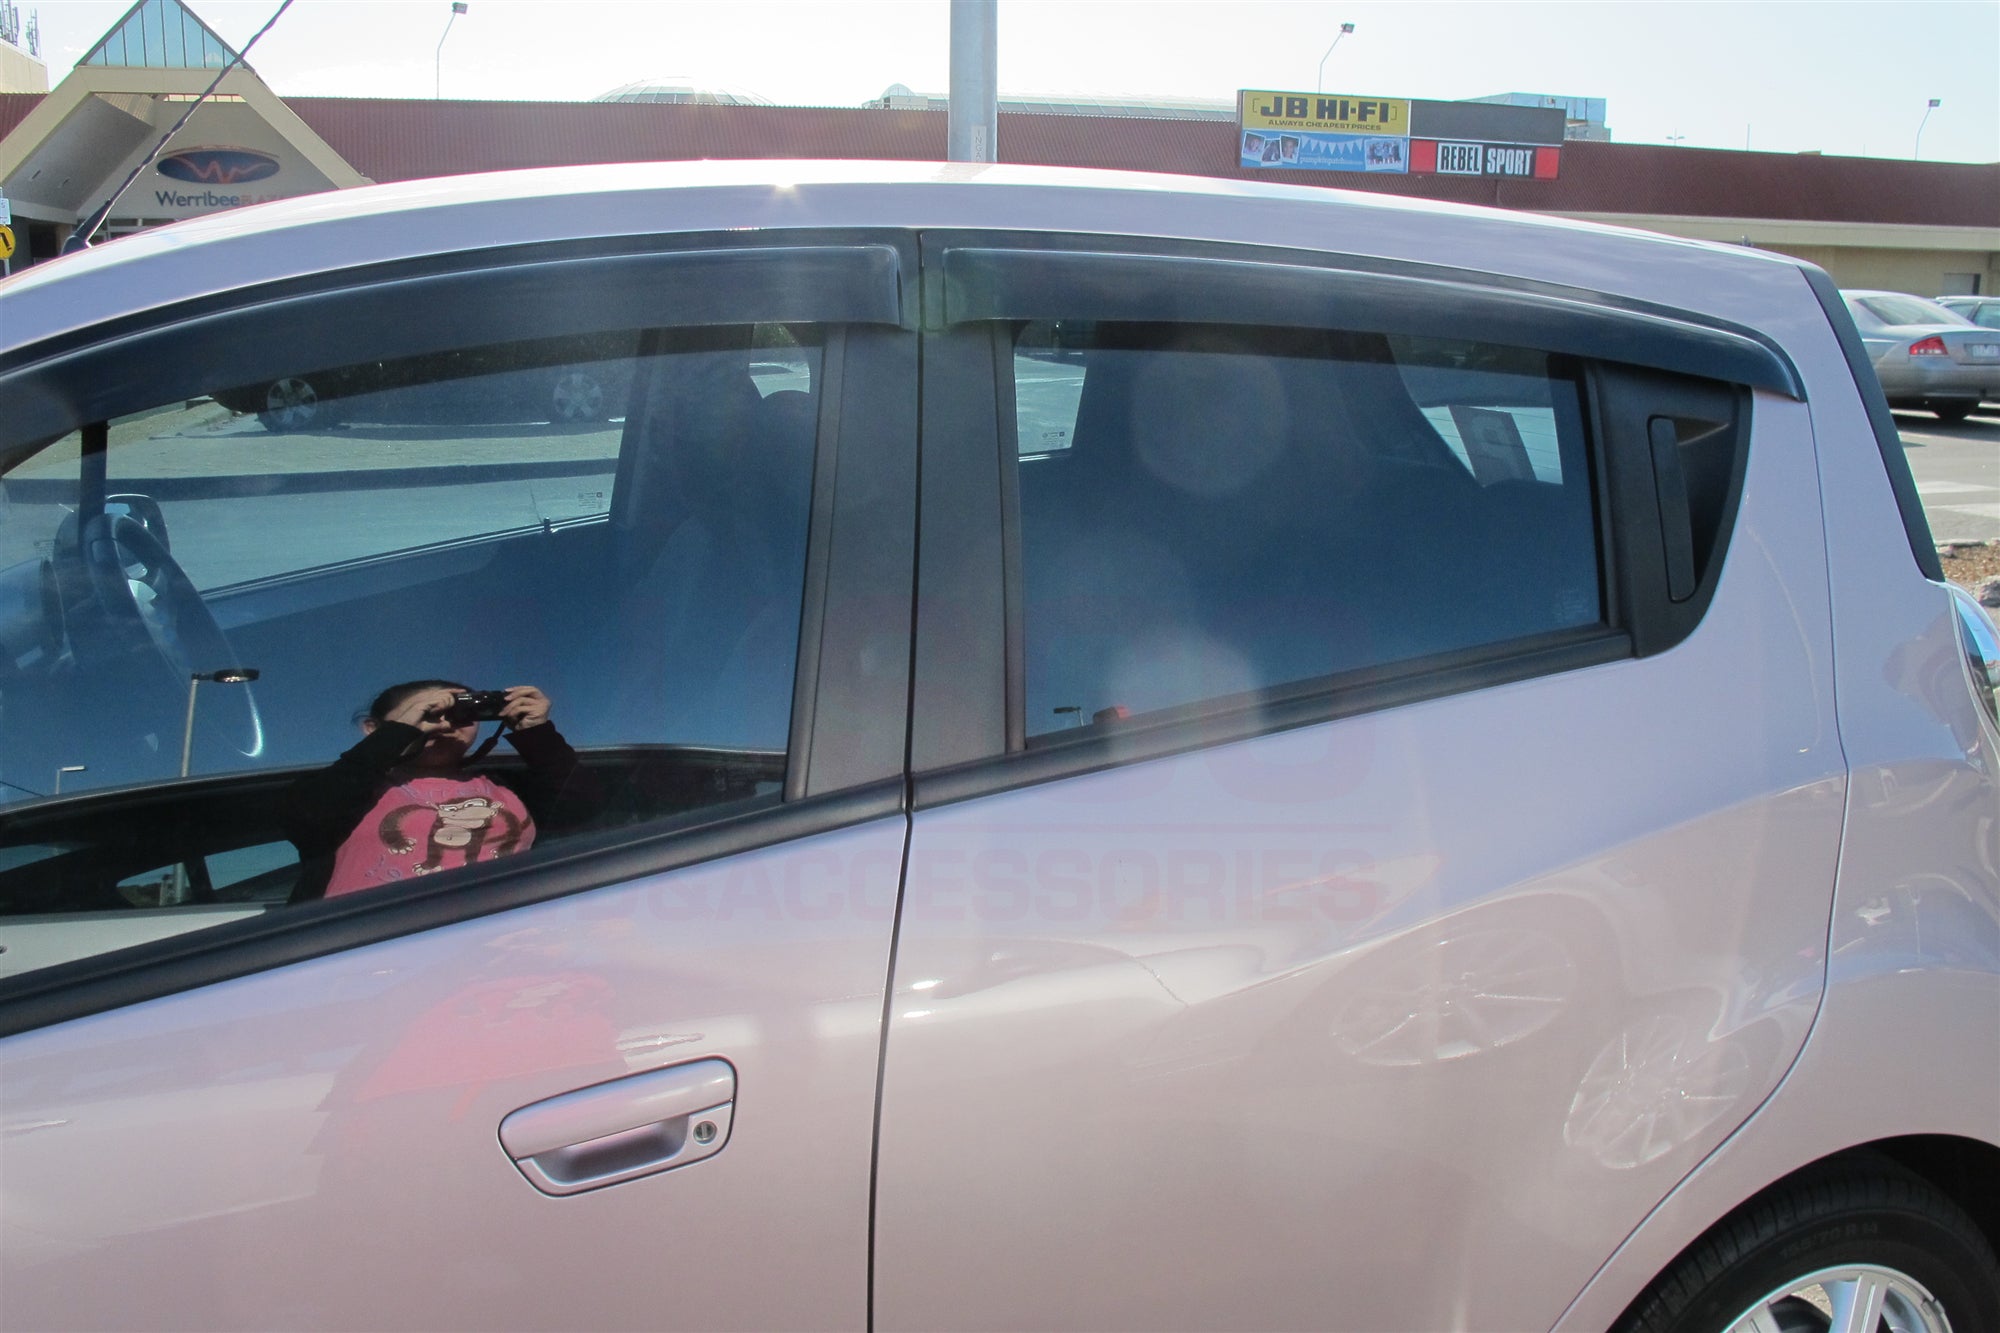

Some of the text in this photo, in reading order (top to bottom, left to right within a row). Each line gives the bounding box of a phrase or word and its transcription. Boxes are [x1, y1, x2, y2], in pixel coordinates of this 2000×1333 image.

[1261, 96, 1389, 123] JB HI-FI
[1306, 121, 1351, 129] CHEAPEST
[1352, 123, 1381, 131] PRICES
[1441, 145, 1533, 176] REBEL SPORT
[155, 190, 240, 207] Werribee
